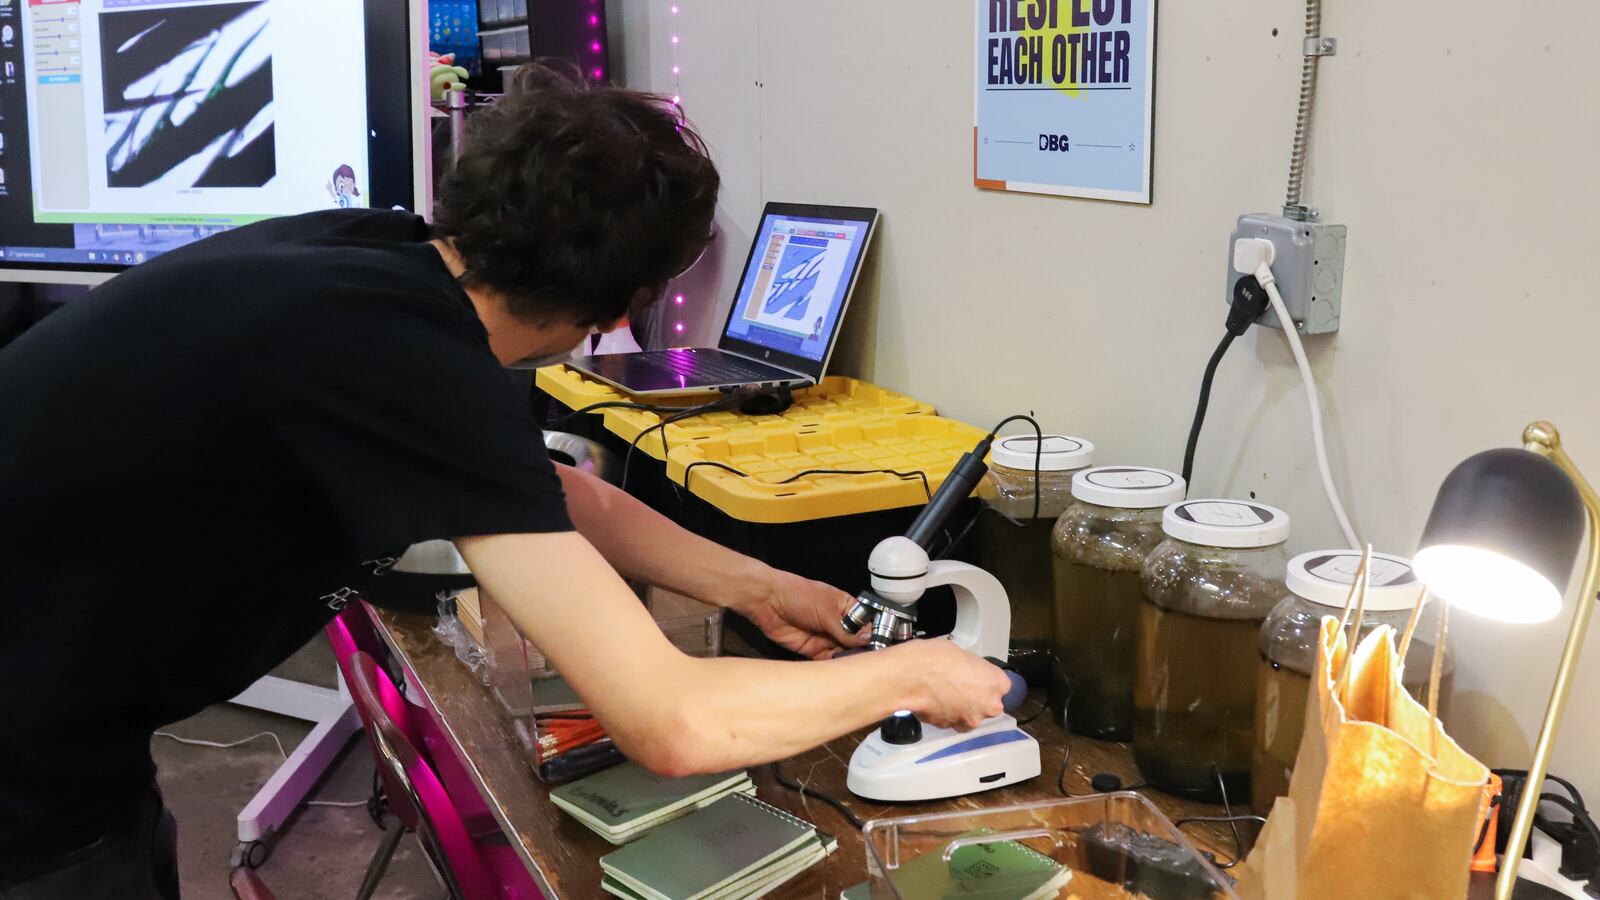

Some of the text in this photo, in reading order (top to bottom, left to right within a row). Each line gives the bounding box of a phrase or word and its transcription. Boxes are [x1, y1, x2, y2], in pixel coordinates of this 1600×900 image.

[988, 31, 1131, 85] EACH OTHER
[1039, 134, 1069, 152] DBG
